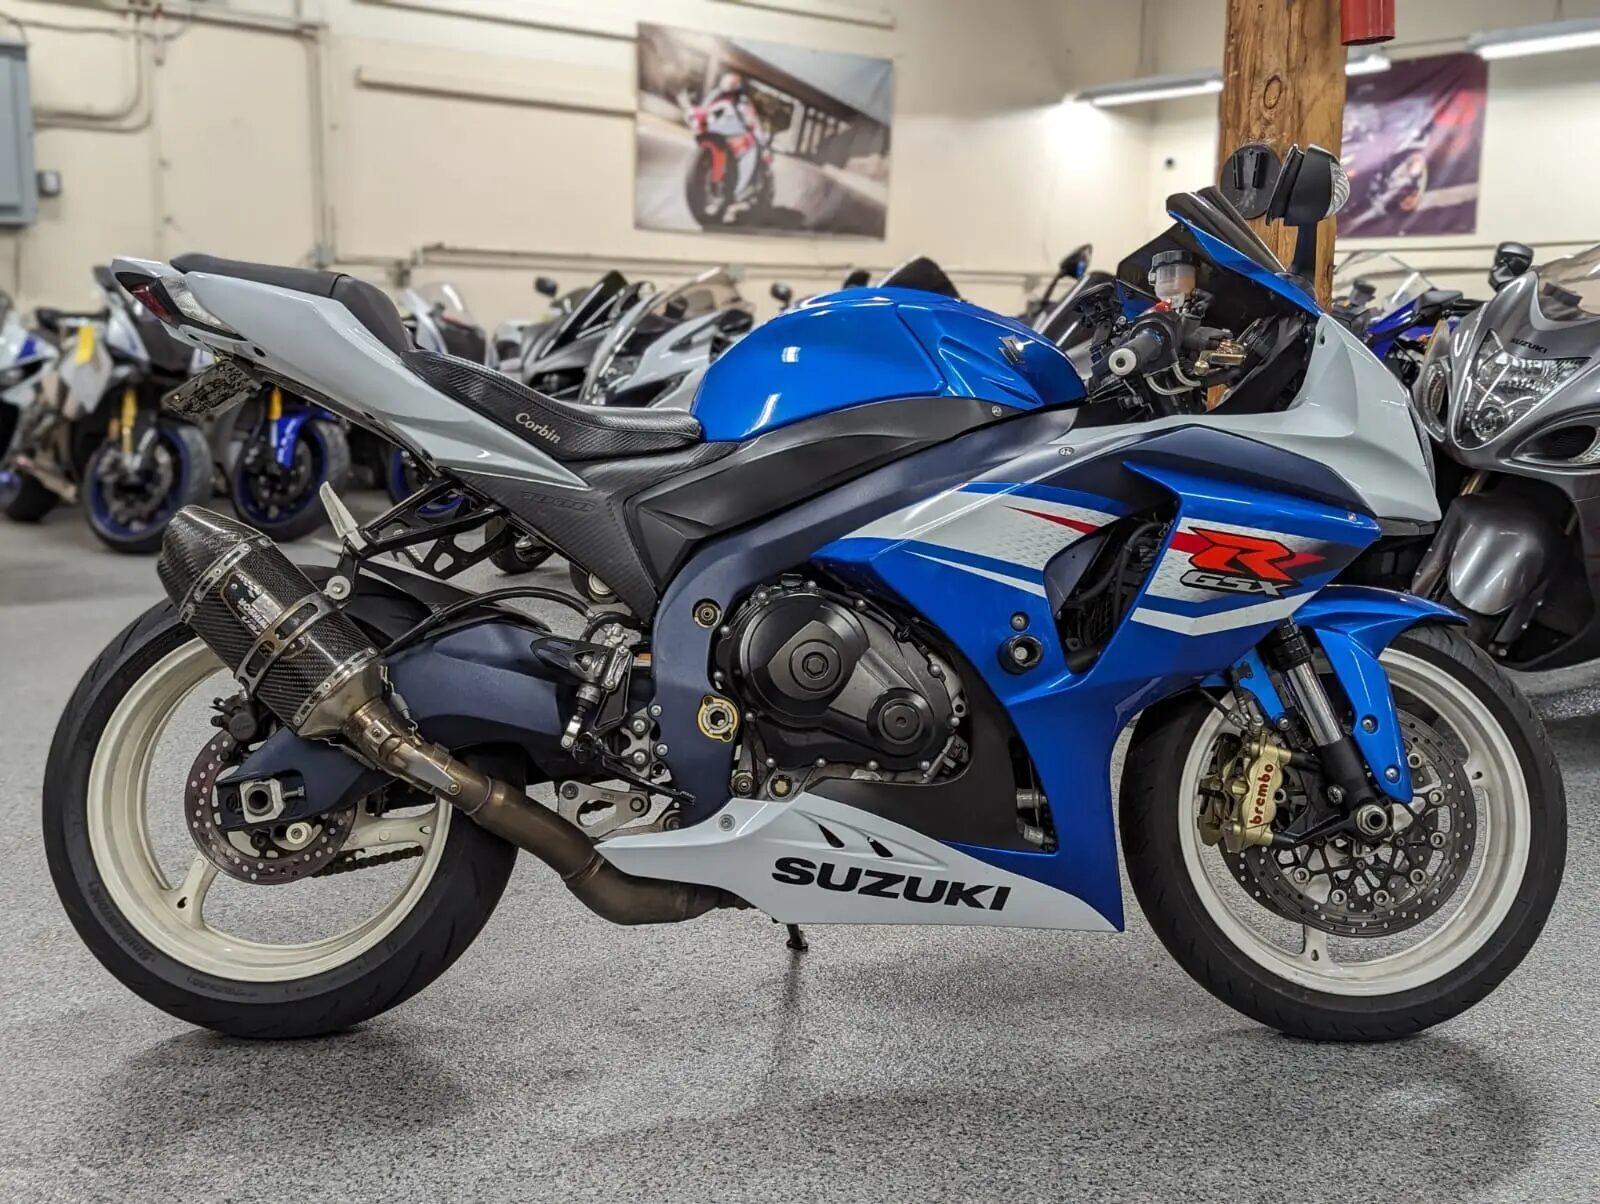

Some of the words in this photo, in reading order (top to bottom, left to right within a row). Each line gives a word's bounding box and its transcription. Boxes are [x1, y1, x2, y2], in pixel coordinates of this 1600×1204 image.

[1510, 337, 1548, 354] SUZUKI
[515, 412, 561, 444] Corbin
[1188, 526, 1302, 583] R
[1179, 569, 1293, 599] GSX
[1249, 763, 1274, 825] brembo
[771, 856, 1012, 911] SUZUKI
